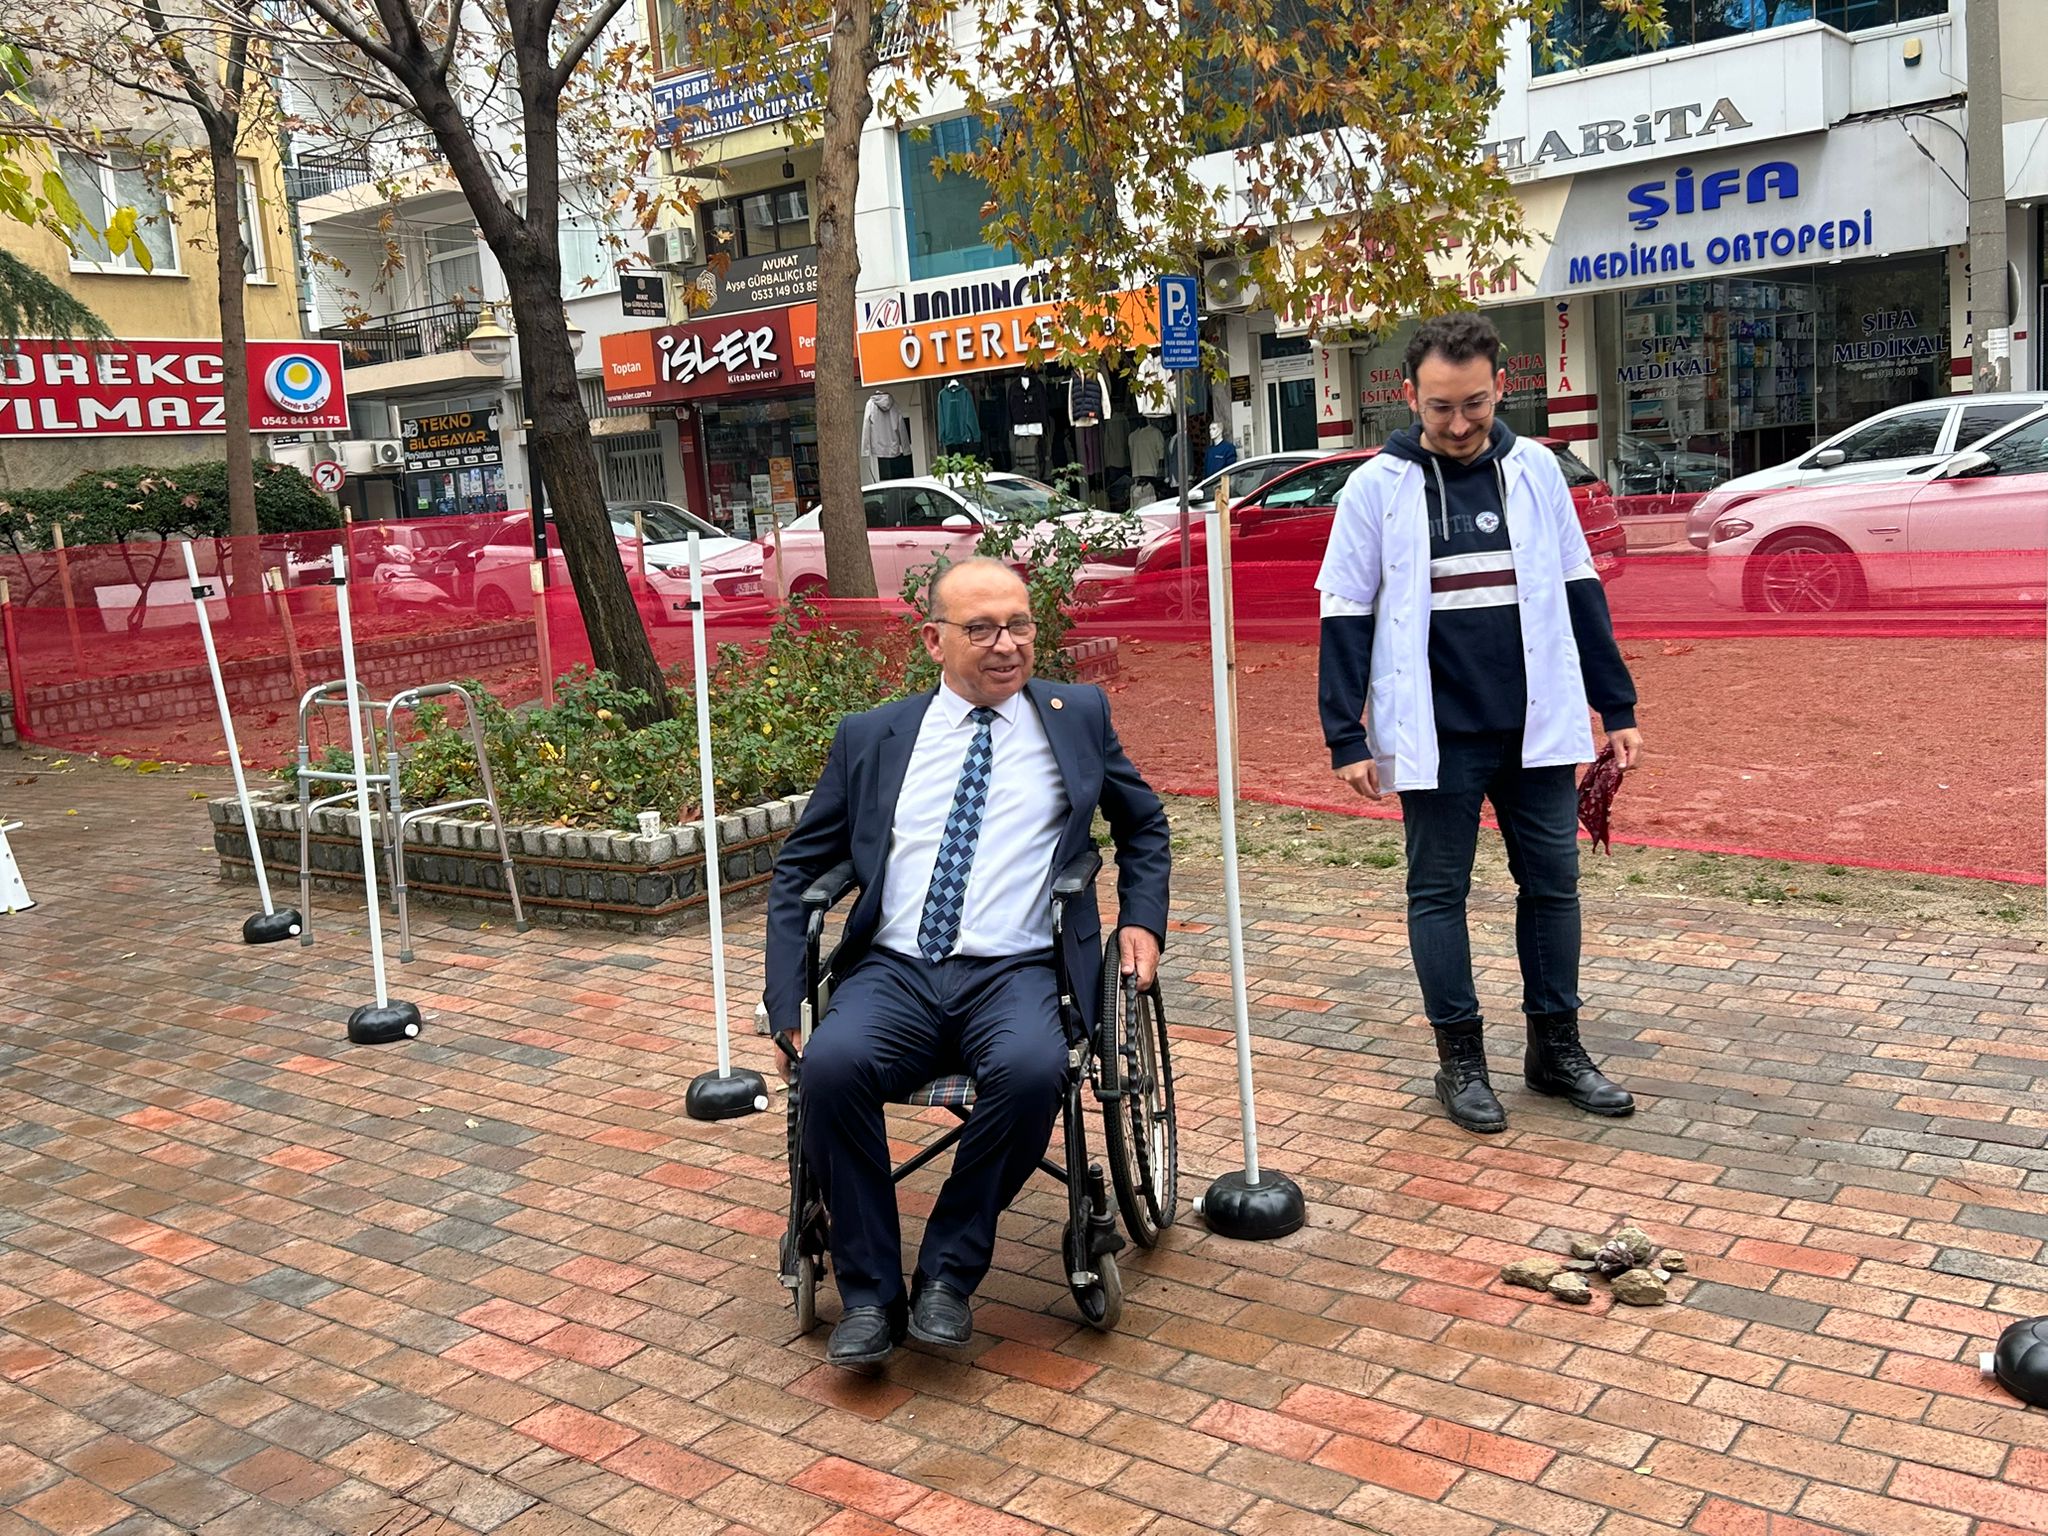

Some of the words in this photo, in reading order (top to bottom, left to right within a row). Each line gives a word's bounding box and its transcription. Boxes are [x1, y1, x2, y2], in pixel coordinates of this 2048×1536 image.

[1628, 161, 1798, 231] ŞİFA
[1569, 242, 1694, 284] MEDİKAL
[1706, 208, 1872, 265] ORTOPEDİ
[762, 255, 798, 272] AVUKAT
[726, 281, 746, 292] Ayşe
[748, 269, 802, 288] GÜRBALIKÇI
[751, 288, 773, 301] 0533
[775, 285, 790, 297] 149
[792, 282, 804, 294] 03
[1167, 283, 1186, 326] P
[1862, 307, 1917, 336] ŞİFA
[1642, 334, 1689, 362] ŞİFA
[1833, 334, 1949, 364] MEDİKAL
[611, 362, 642, 376] Toptan
[728, 370, 777, 384] Kitabevleri
[1616, 357, 1717, 384] MEDİKAL
[262, 416, 288, 426] 0542
[290, 415, 308, 425] 841
[312, 415, 324, 425] 91
[327, 415, 341, 424] 75
[420, 413, 472, 432] TEKNO
